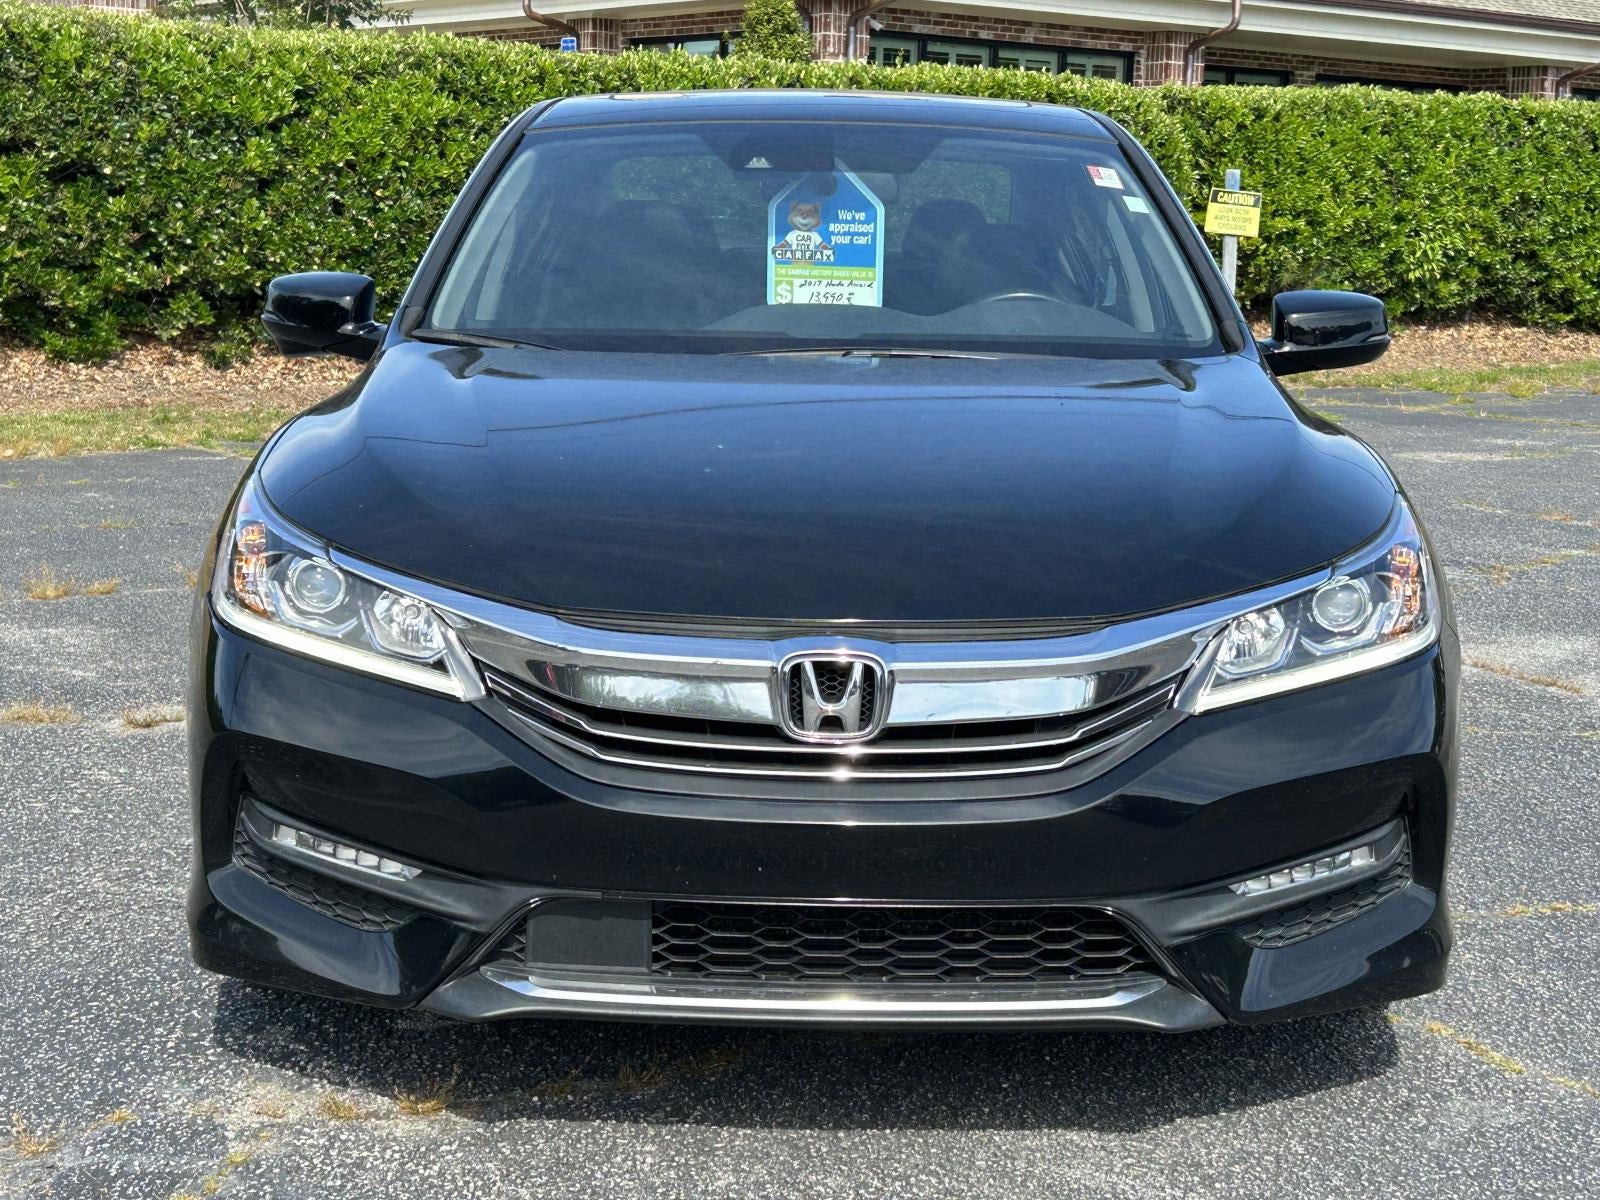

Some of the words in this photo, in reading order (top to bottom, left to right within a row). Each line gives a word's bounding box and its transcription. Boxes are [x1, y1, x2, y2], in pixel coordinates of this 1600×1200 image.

[1217, 191, 1255, 206] CAUTION
[838, 209, 865, 221] We've
[829, 222, 874, 233] appraised
[795, 234, 812, 243] CAR
[831, 235, 851, 246] your
[852, 235, 872, 245] car!
[796, 242, 811, 250] FOX
[775, 250, 833, 262] CARFAX
[776, 282, 792, 304] $
